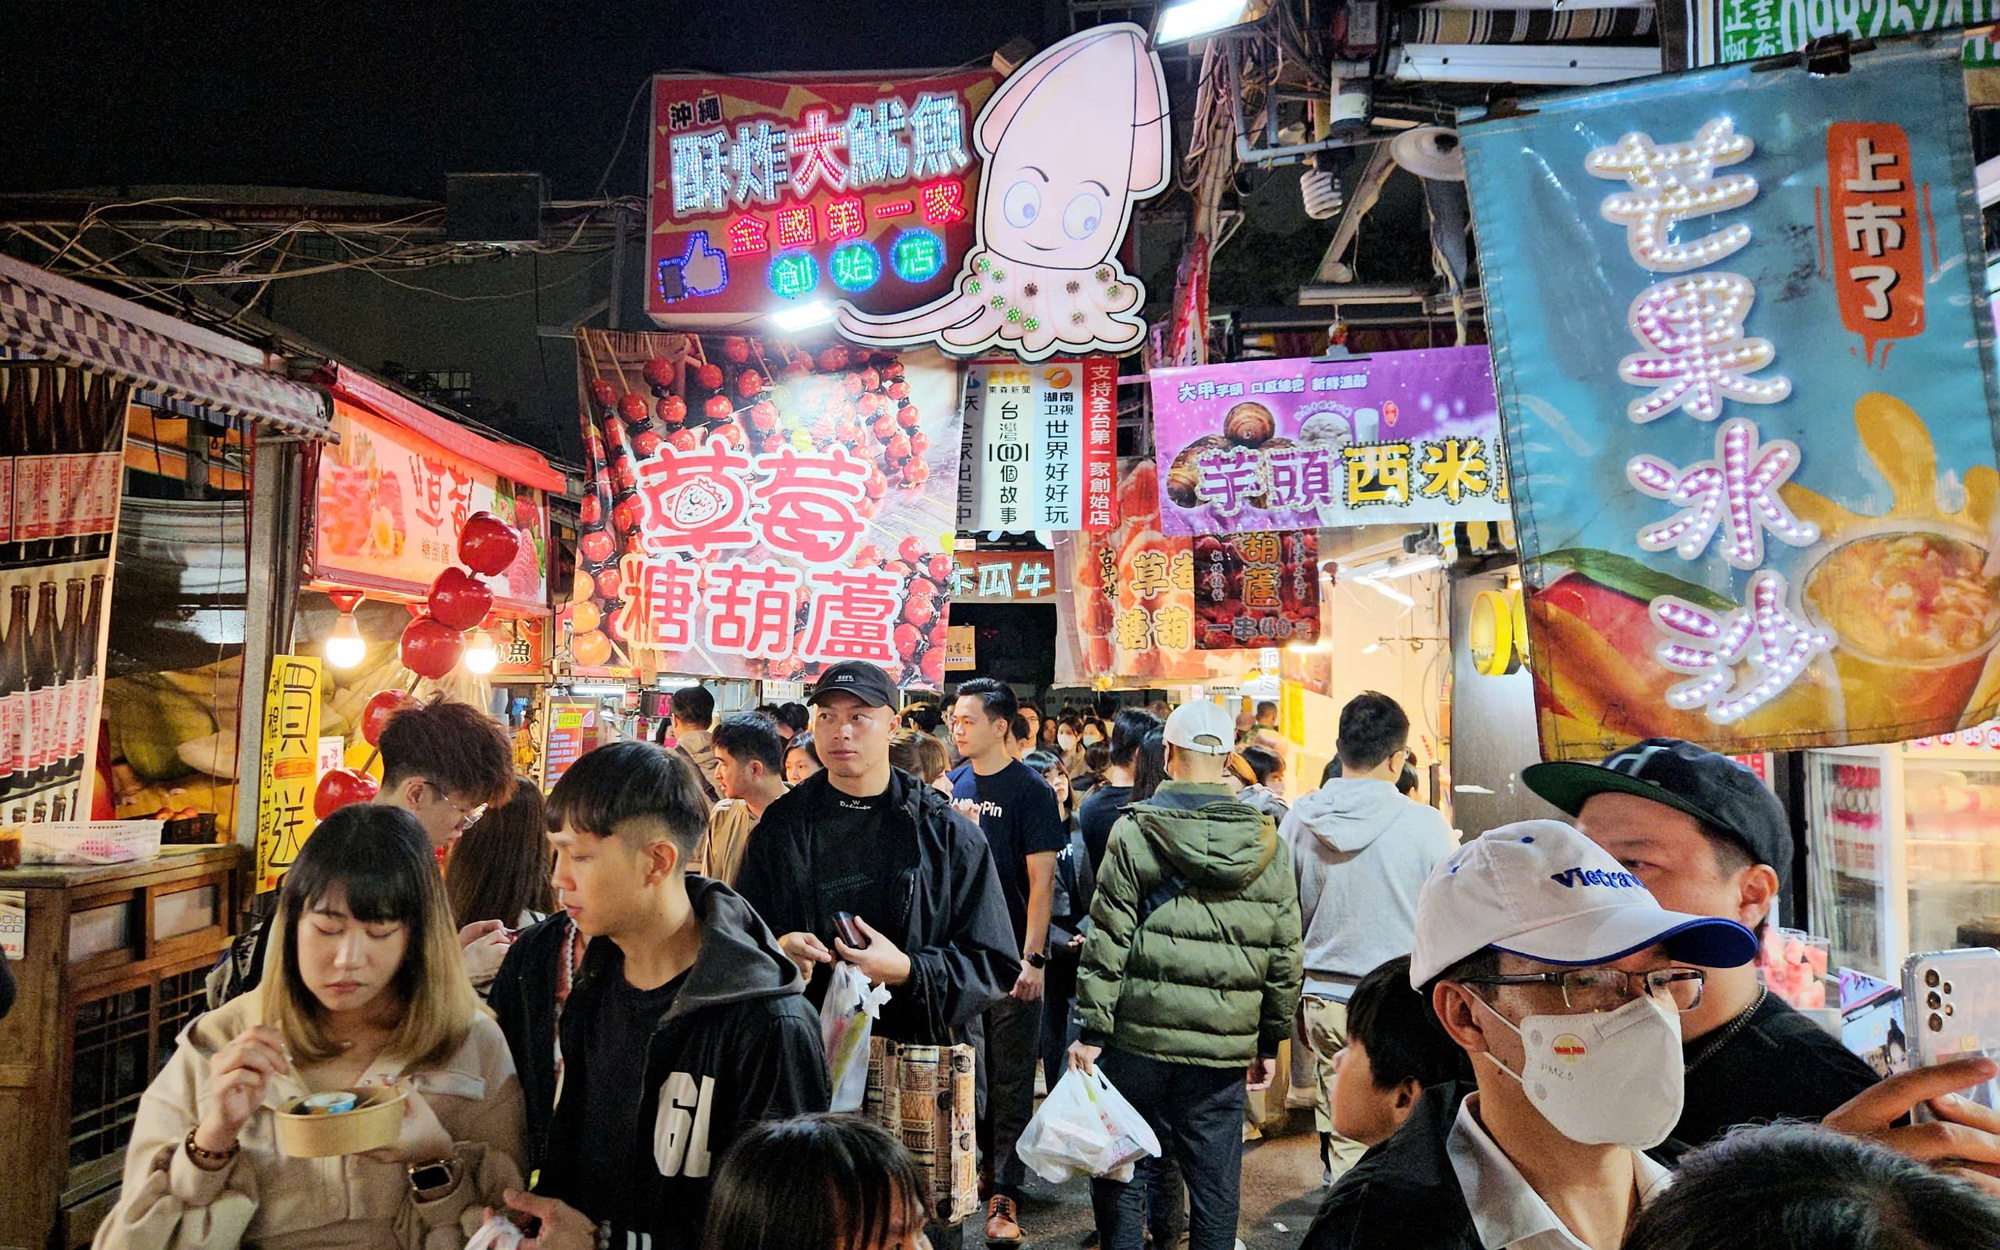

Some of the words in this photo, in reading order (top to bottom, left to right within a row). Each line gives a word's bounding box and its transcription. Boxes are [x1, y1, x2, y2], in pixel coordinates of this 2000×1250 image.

[671, 93, 972, 212] 酥炸大魷魚
[728, 182, 967, 254] 全國第一家
[1844, 138, 1903, 321] 上市了
[772, 231, 941, 295] 創始店
[989, 371, 1031, 384] EBC
[989, 386, 1031, 394] 東森新聞
[1044, 392, 1073, 402] 湖南
[1044, 405, 1073, 415] 卫视
[1178, 381, 1243, 401] 大甲芋頭
[1089, 365, 1112, 526] 支持全台第一家創始店
[1584, 114, 1838, 725] 芒果冰沙
[639, 438, 870, 562] 草莓
[1045, 420, 1069, 523] 世界好好玩
[1195, 439, 1511, 514] 芋頭西米
[1101, 547, 1119, 599] 古早味
[619, 558, 902, 664] 糖葫蘆
